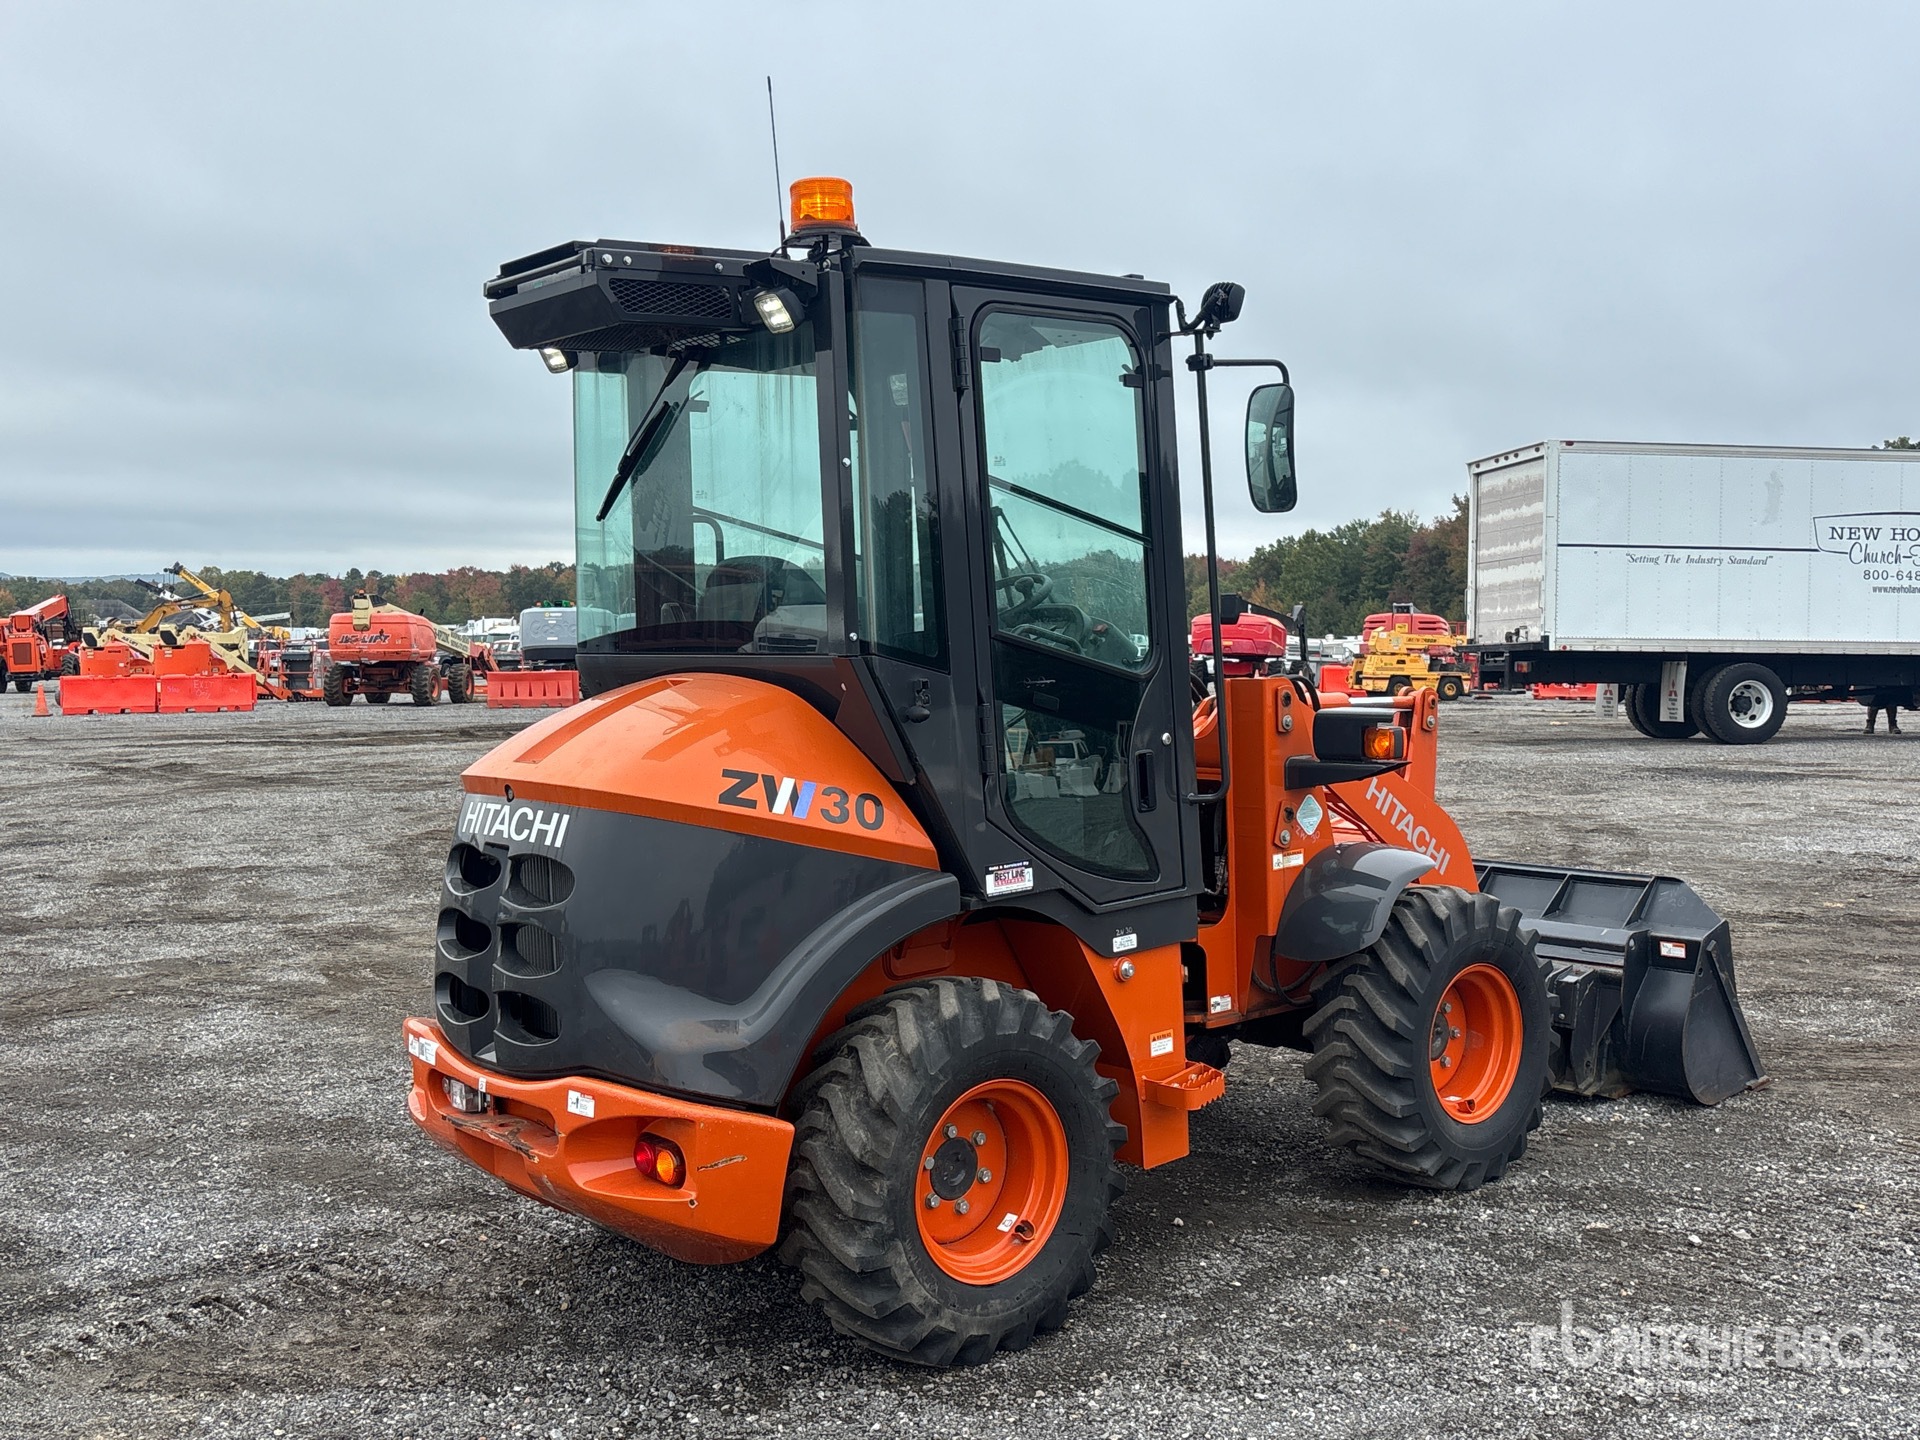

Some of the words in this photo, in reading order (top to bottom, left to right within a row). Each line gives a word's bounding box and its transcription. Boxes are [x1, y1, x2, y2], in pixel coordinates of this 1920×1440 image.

[1828, 526, 1882, 541] NEW
[1664, 554, 1681, 565] The
[1685, 554, 1724, 567] Industry
[1849, 541, 1902, 565] Church
[461, 801, 570, 848] HITACHI
[1365, 776, 1451, 875] HITACHI
